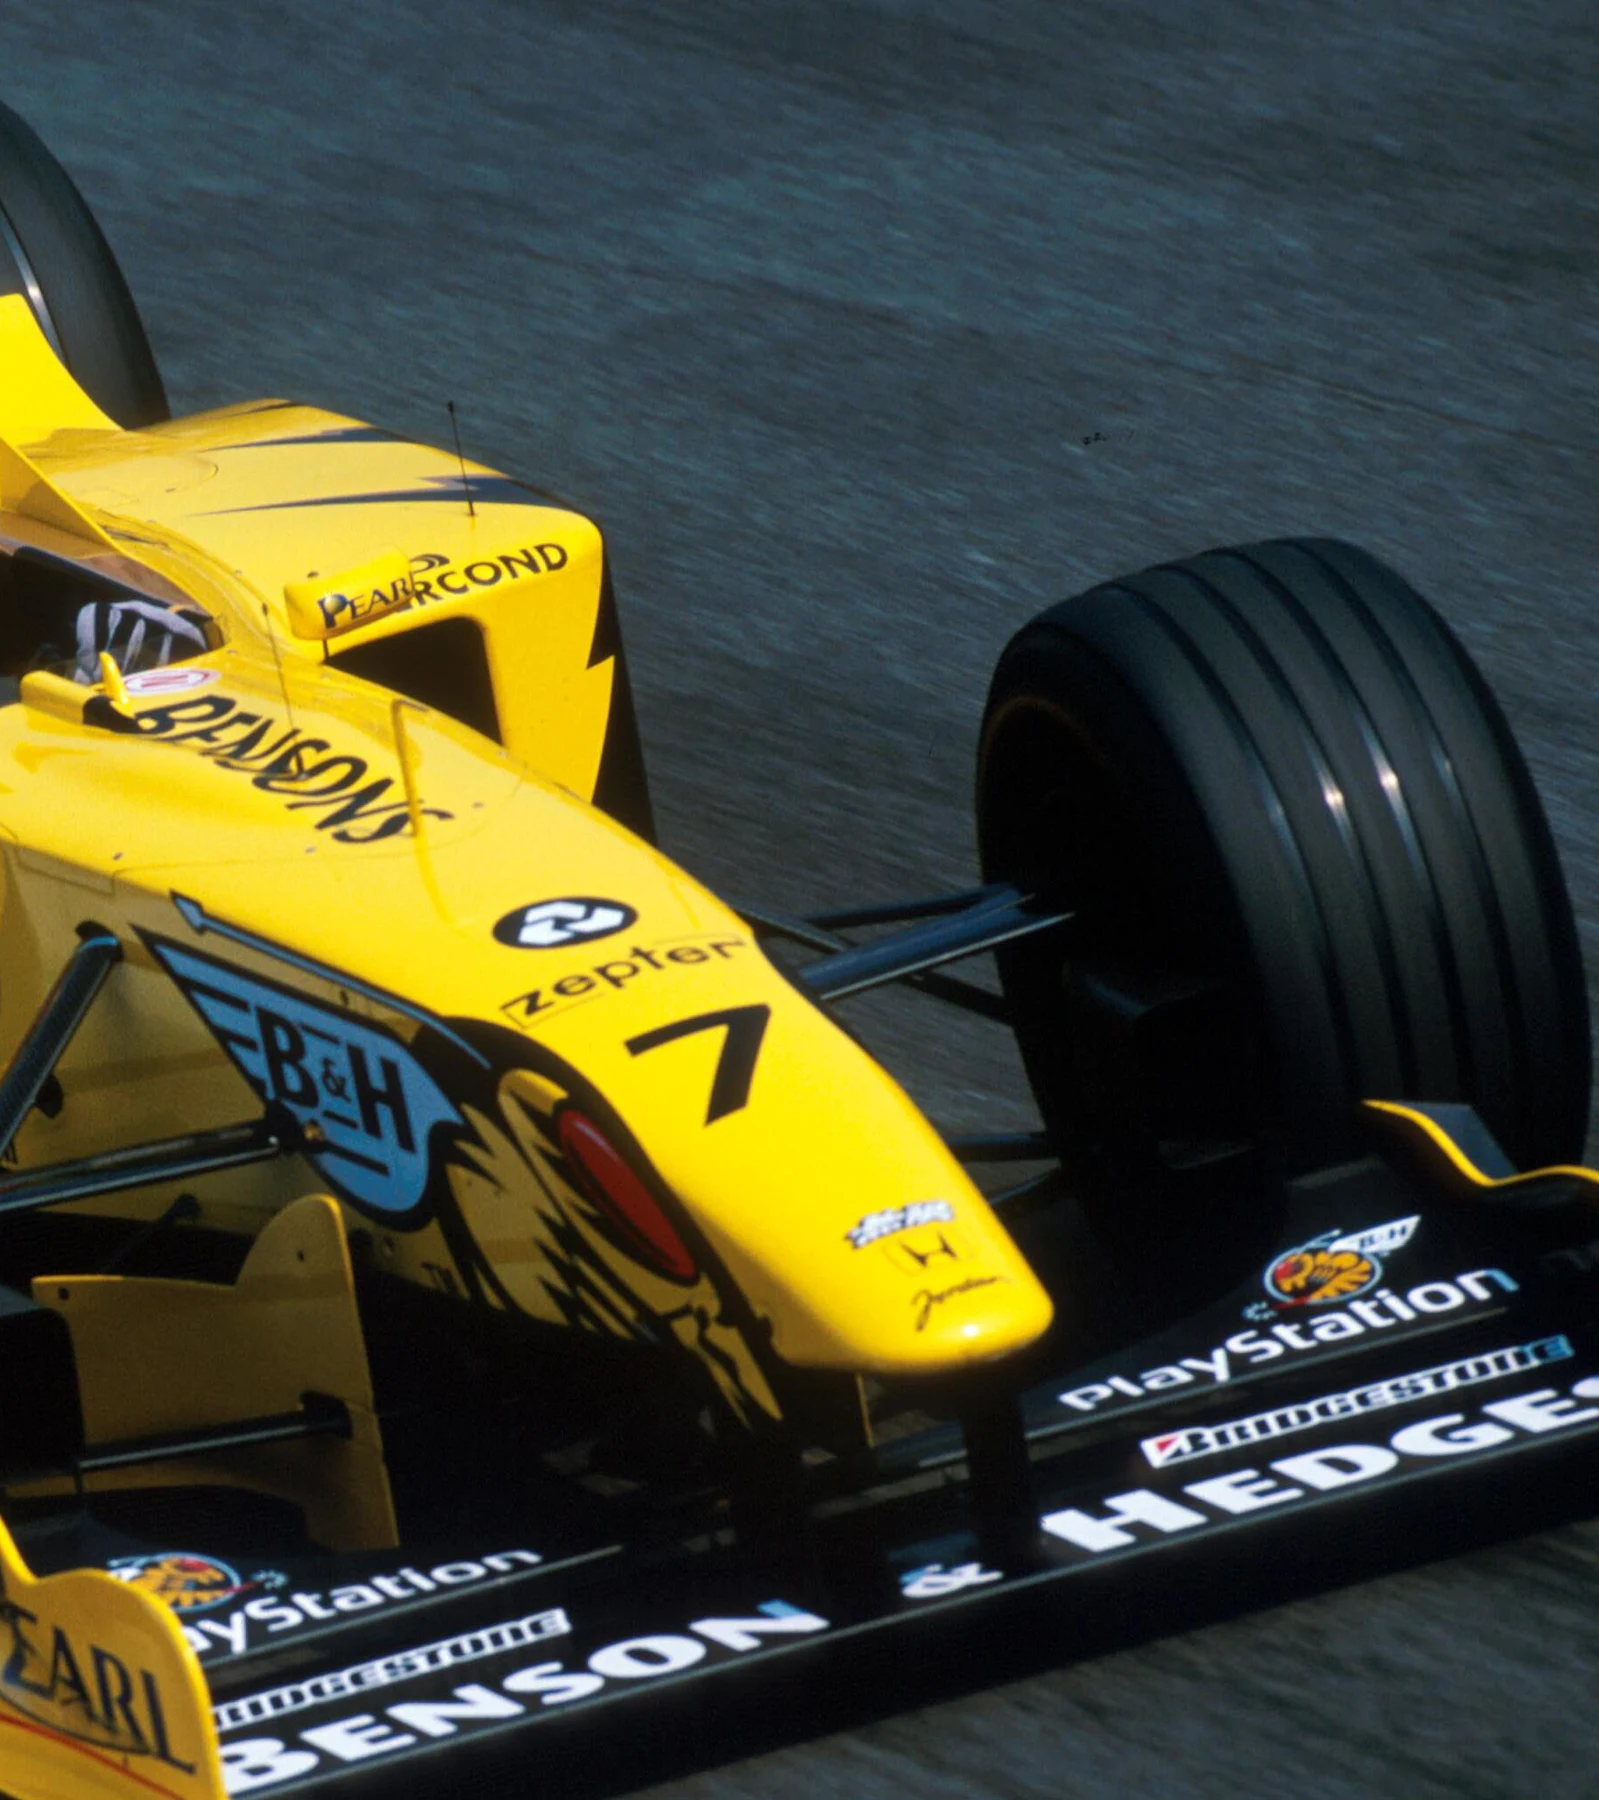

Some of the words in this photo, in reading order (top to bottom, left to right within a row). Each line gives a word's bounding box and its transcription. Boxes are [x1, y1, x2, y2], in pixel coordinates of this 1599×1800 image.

[500, 941, 745, 1016] zepter
[255, 1006, 416, 1154] B&H
[623, 1003, 771, 1127] 7
[1059, 1268, 1519, 1410] PlayStation
[1140, 1334, 1575, 1469] BRIDGESTONE
[218, 1599, 830, 1796] BENSON
[899, 1563, 1005, 1599] &
